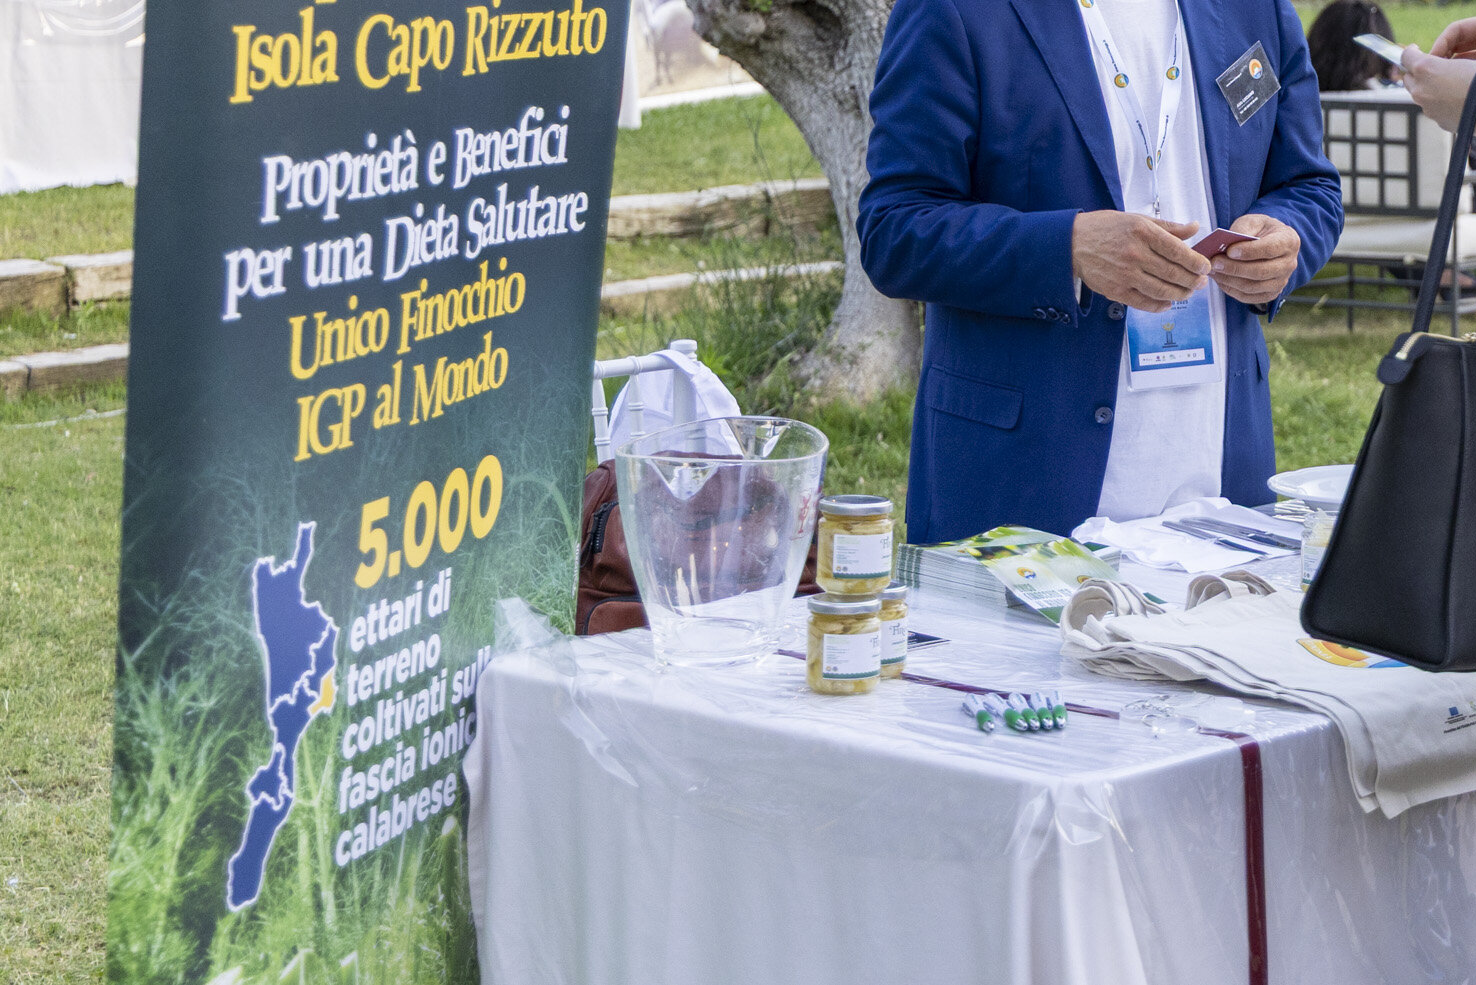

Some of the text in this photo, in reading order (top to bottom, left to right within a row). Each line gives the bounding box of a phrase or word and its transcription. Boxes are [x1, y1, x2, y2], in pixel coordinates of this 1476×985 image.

[230, 6, 339, 103] Isola
[355, 13, 455, 93] Capo
[261, 104, 571, 224] Proprietà e Benefici
[222, 182, 588, 321] per una Dieta Salutare
[289, 257, 526, 379] Unico Finocchio
[294, 331, 509, 462] IGP al Mondo
[354, 454, 504, 589] 5.000
[349, 567, 452, 652] ettari di
[341, 667, 448, 760] coltivati
[346, 634, 441, 707] terreno
[338, 706, 477, 814] fascia ionic
[334, 772, 458, 868] calabrese
